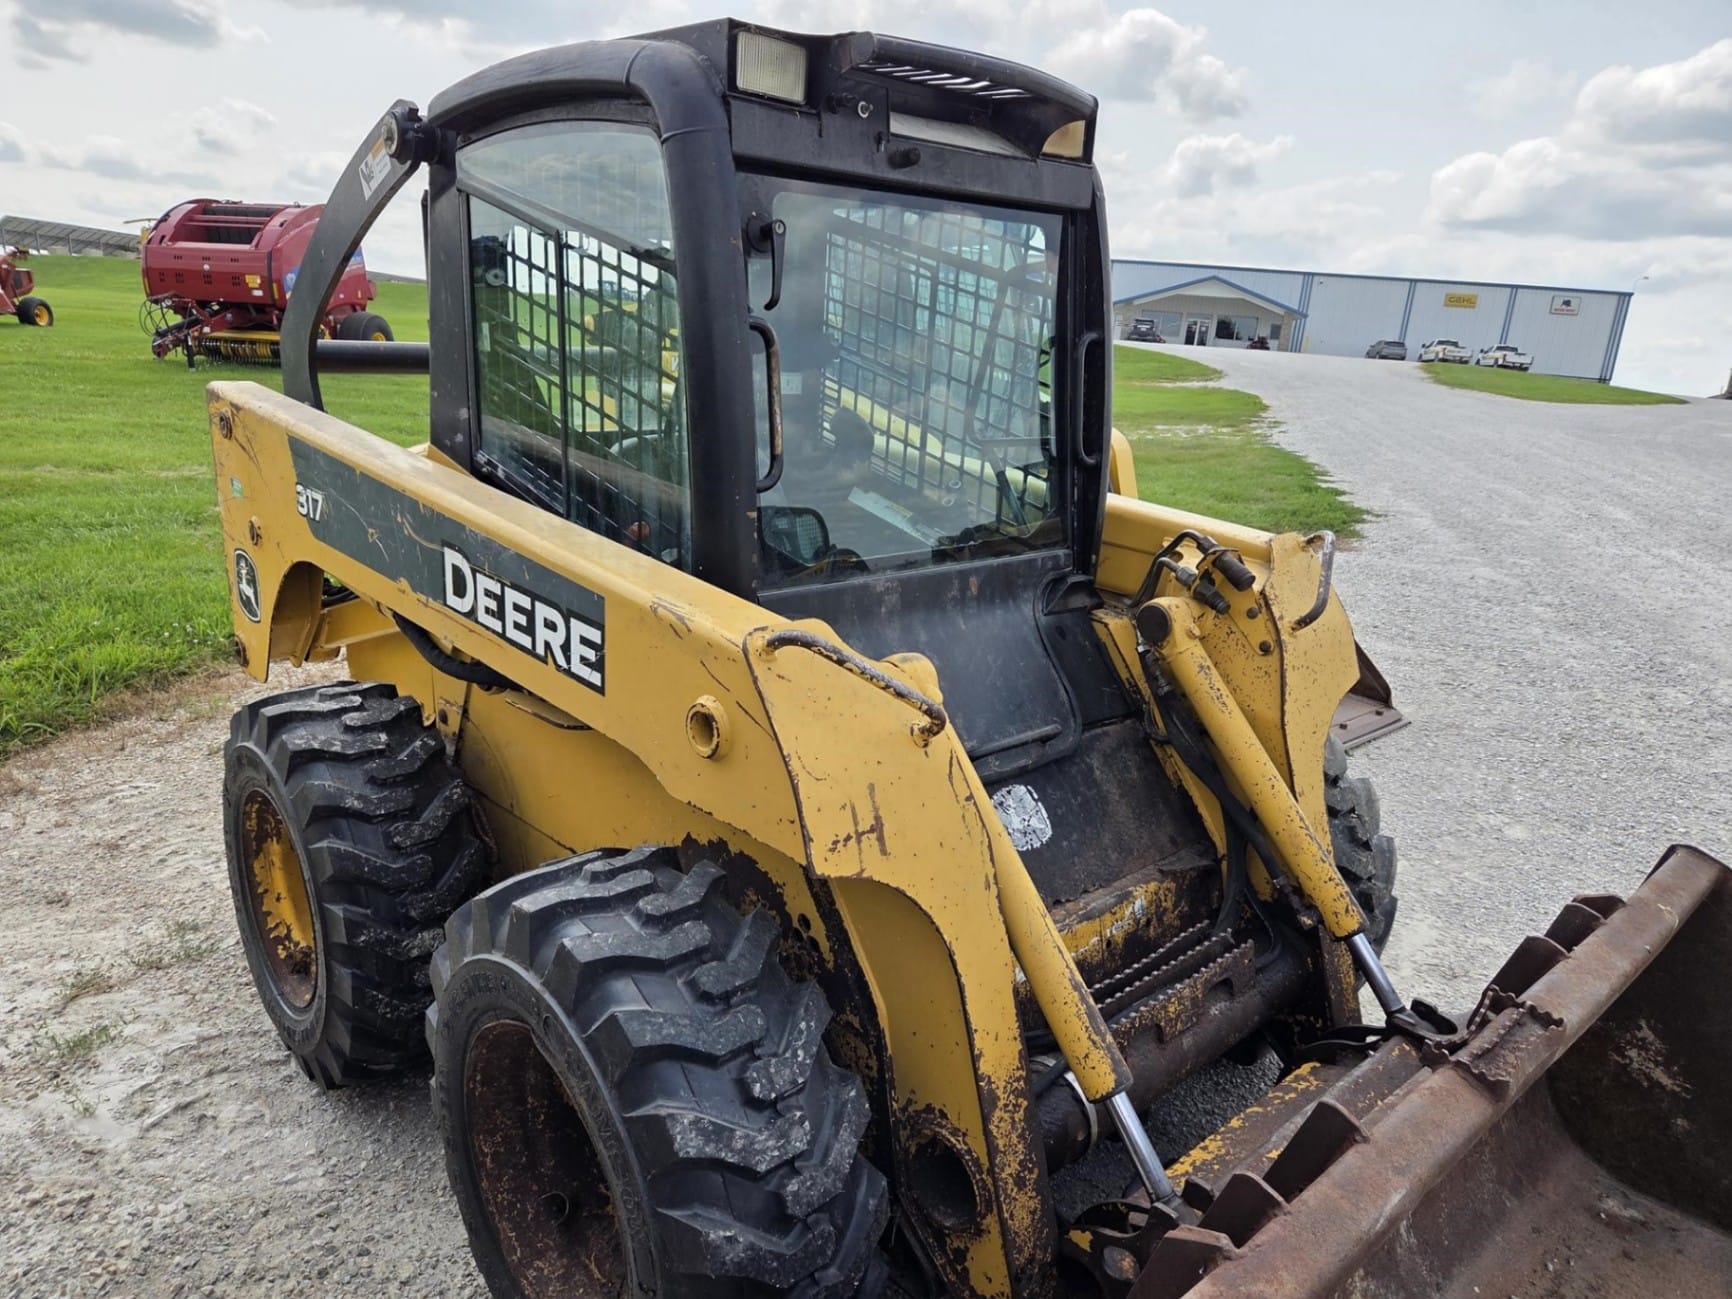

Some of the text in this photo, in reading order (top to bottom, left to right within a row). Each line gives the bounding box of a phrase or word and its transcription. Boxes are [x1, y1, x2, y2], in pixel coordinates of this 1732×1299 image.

[1447, 296, 1476, 305] GEHL
[296, 483, 322, 521] 317
[443, 546, 602, 687] DEERE
